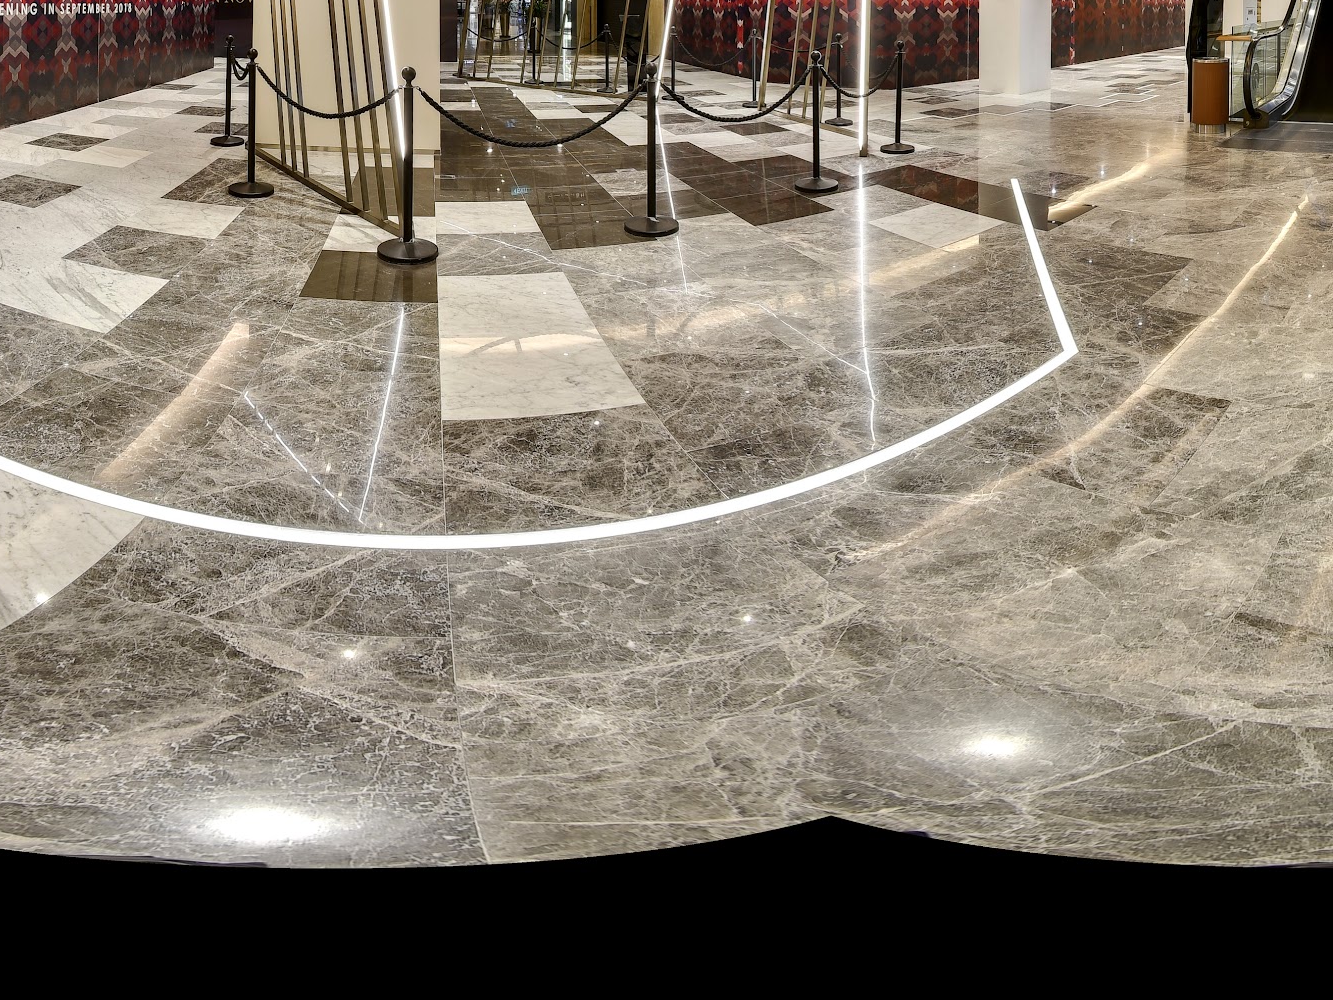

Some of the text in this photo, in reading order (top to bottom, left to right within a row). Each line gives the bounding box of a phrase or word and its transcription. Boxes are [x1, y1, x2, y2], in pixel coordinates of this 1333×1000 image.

[43, 3, 55, 15] IN
[60, 3, 110, 14] SEPTEMBER
[114, 2, 132, 13] 2018
